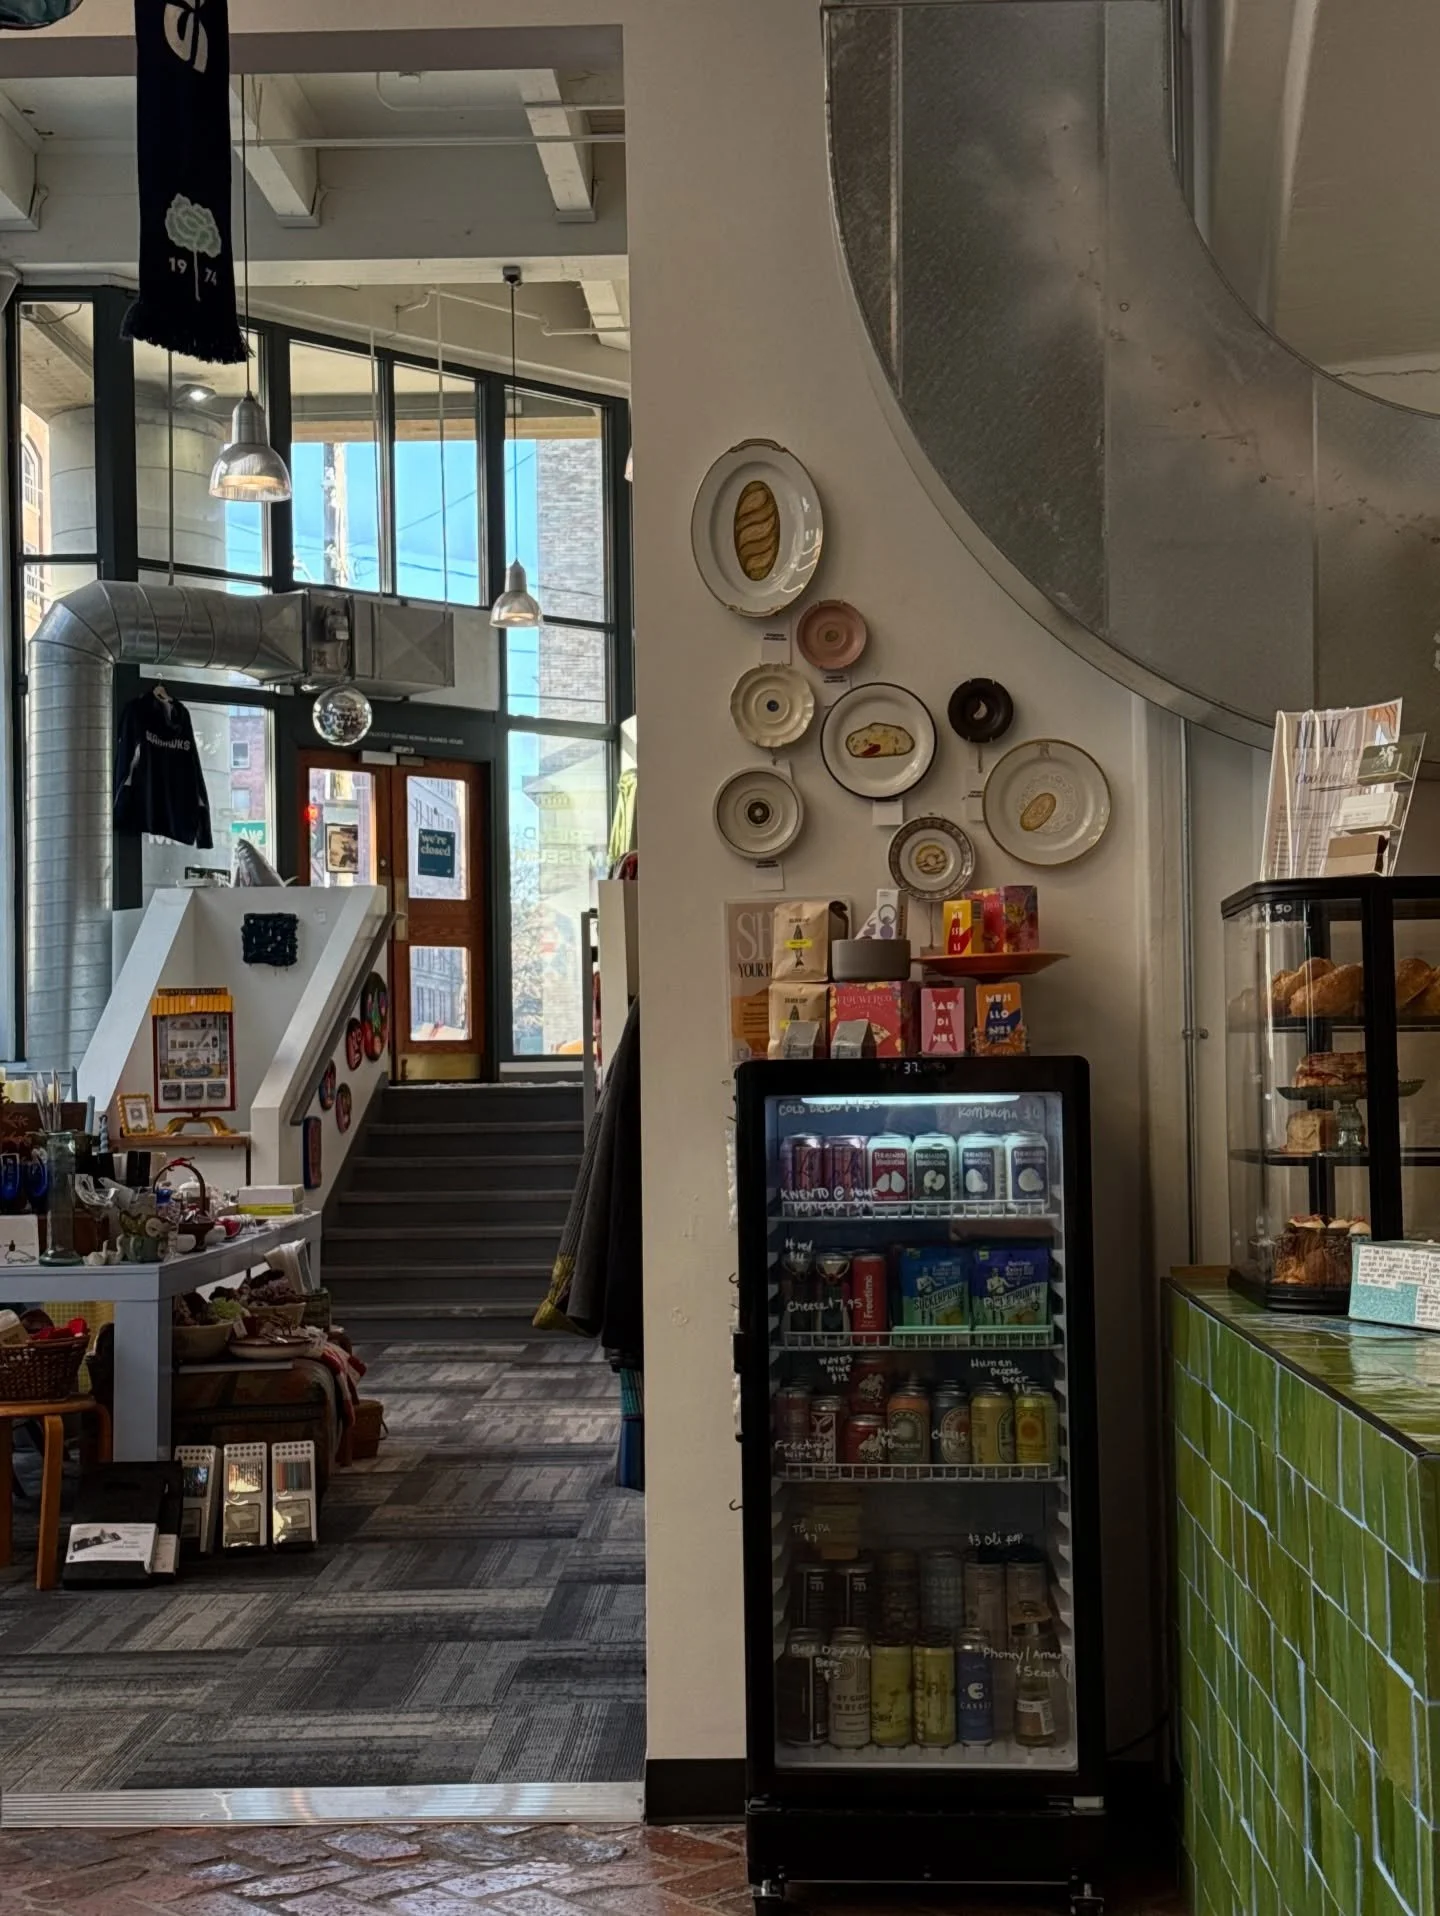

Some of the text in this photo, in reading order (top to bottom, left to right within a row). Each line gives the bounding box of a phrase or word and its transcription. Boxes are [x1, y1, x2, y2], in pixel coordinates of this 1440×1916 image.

[168, 257, 187, 273] 19
[203, 268, 217, 286] 74
[239, 827, 264, 844] Ave
[421, 834, 448, 845] we're
[420, 842, 451, 857] closed
[738, 963, 765, 980] YOUR
[931, 1001, 955, 1010] SAR
[936, 1017, 949, 1026] DI
[989, 1009, 1009, 1020] LLO
